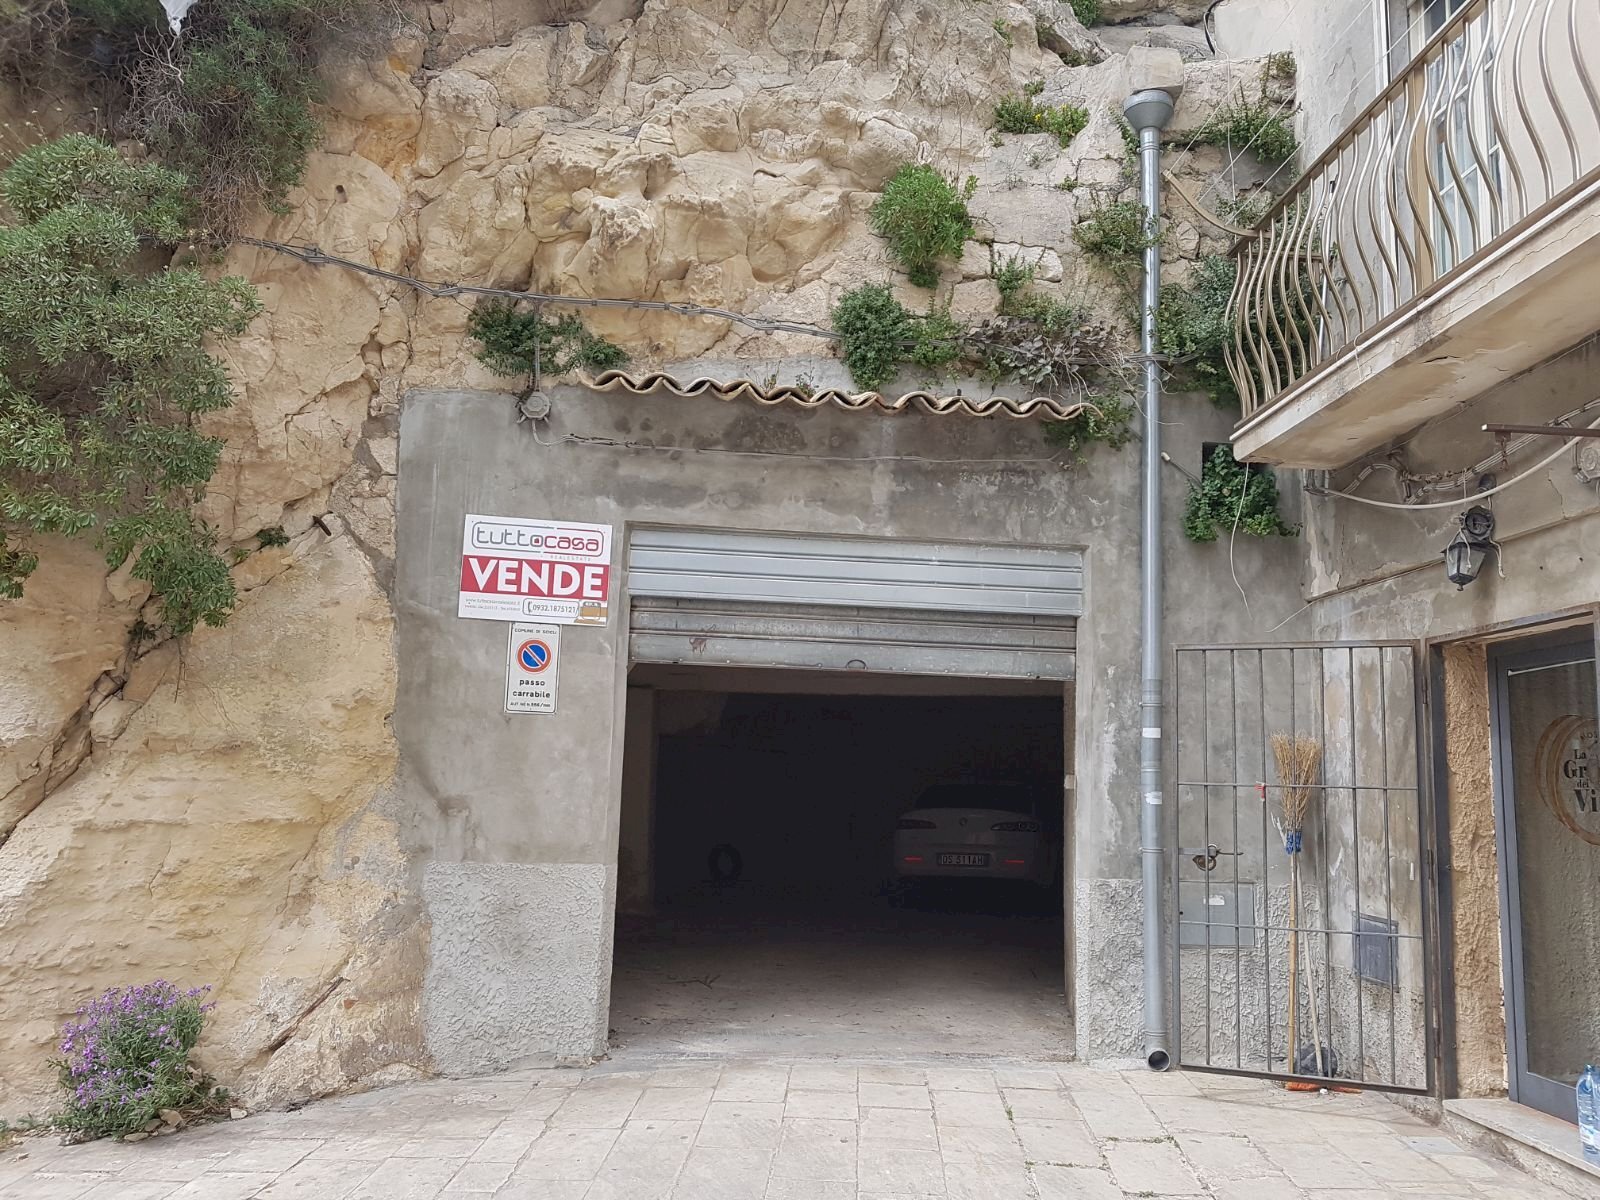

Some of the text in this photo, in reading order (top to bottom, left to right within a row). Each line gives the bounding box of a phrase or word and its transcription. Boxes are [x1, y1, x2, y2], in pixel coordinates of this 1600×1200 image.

[476, 526, 599, 552] tuttocasa
[468, 557, 604, 598] VENDE
[519, 679, 546, 687] passo
[512, 691, 551, 699] carrabile
[1574, 749, 1587, 760] La
[1576, 778, 1589, 788] dei
